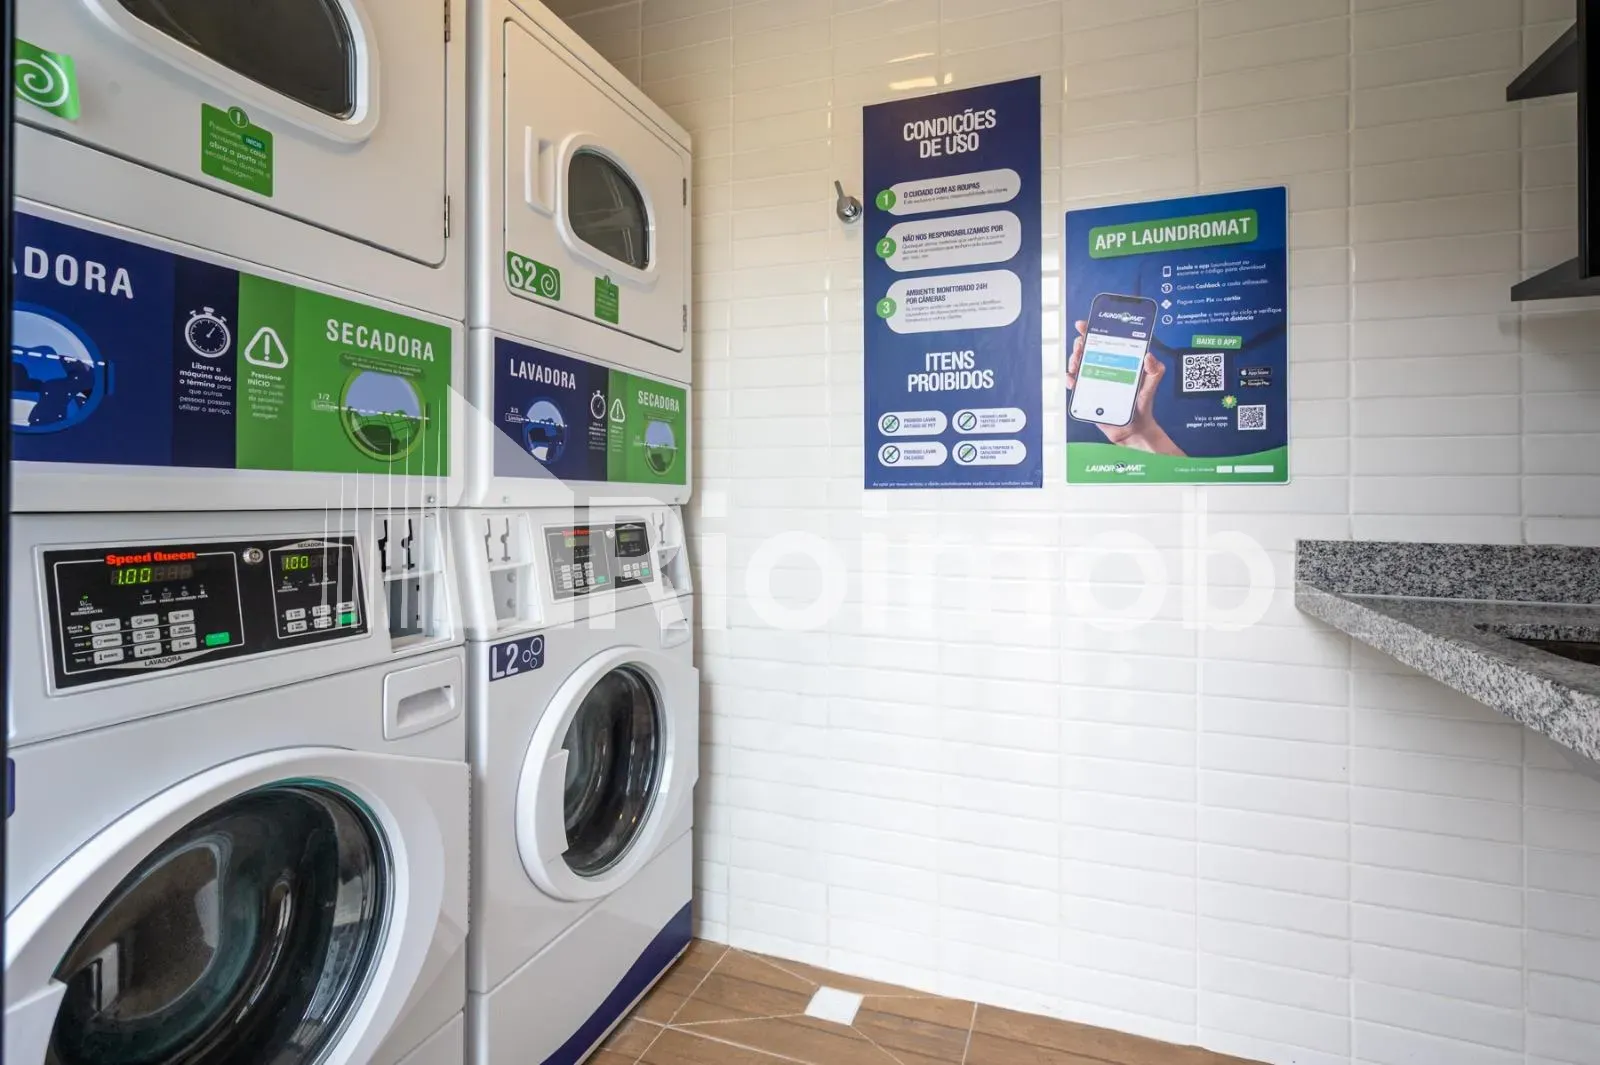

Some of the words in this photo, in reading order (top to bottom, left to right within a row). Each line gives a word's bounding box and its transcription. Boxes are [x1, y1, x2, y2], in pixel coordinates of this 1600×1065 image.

[903, 108, 997, 142] CONDIÇÕES
[919, 138, 942, 159] DE
[945, 132, 980, 155] USO
[903, 191, 908, 199] O
[908, 188, 934, 198] CUIDADO
[934, 186, 948, 195] COM
[948, 185, 957, 193] AS
[956, 181, 981, 192] ROUPAS
[882, 193, 889, 206] 1
[902, 233, 915, 243] NÃO
[915, 232, 928, 241] NOS
[928, 225, 990, 240] RESPONSABILIZAMOS
[990, 224, 1004, 232] POR
[1095, 231, 1127, 251] APP
[1131, 216, 1251, 246] LAUNDROMAT
[882, 241, 890, 255] 2
[13, 246, 134, 299] DORA
[510, 255, 538, 293] S2
[905, 286, 936, 297] AMBIENTE
[936, 283, 975, 295] MONITORADO
[975, 282, 988, 291] 24H
[1195, 281, 1221, 290] Cashback
[882, 300, 890, 315] 3
[905, 297, 918, 305] POR
[918, 294, 947, 304] CÂMERAS
[325, 318, 435, 363] SECADORA
[1196, 337, 1217, 346] BAIXE
[1223, 338, 1237, 346] APP
[191, 361, 215, 372] Libere
[925, 350, 975, 372] ITENS
[179, 369, 214, 381] máquina
[214, 374, 232, 384] após
[186, 378, 216, 389] término
[510, 358, 577, 391] LAVADORA
[907, 369, 995, 393] PROIBIDOS
[637, 390, 680, 413] SECADORA
[106, 553, 152, 567] Speed
[153, 551, 196, 563] Queen
[144, 655, 182, 667] LAVADORA
[492, 643, 519, 680] L2
